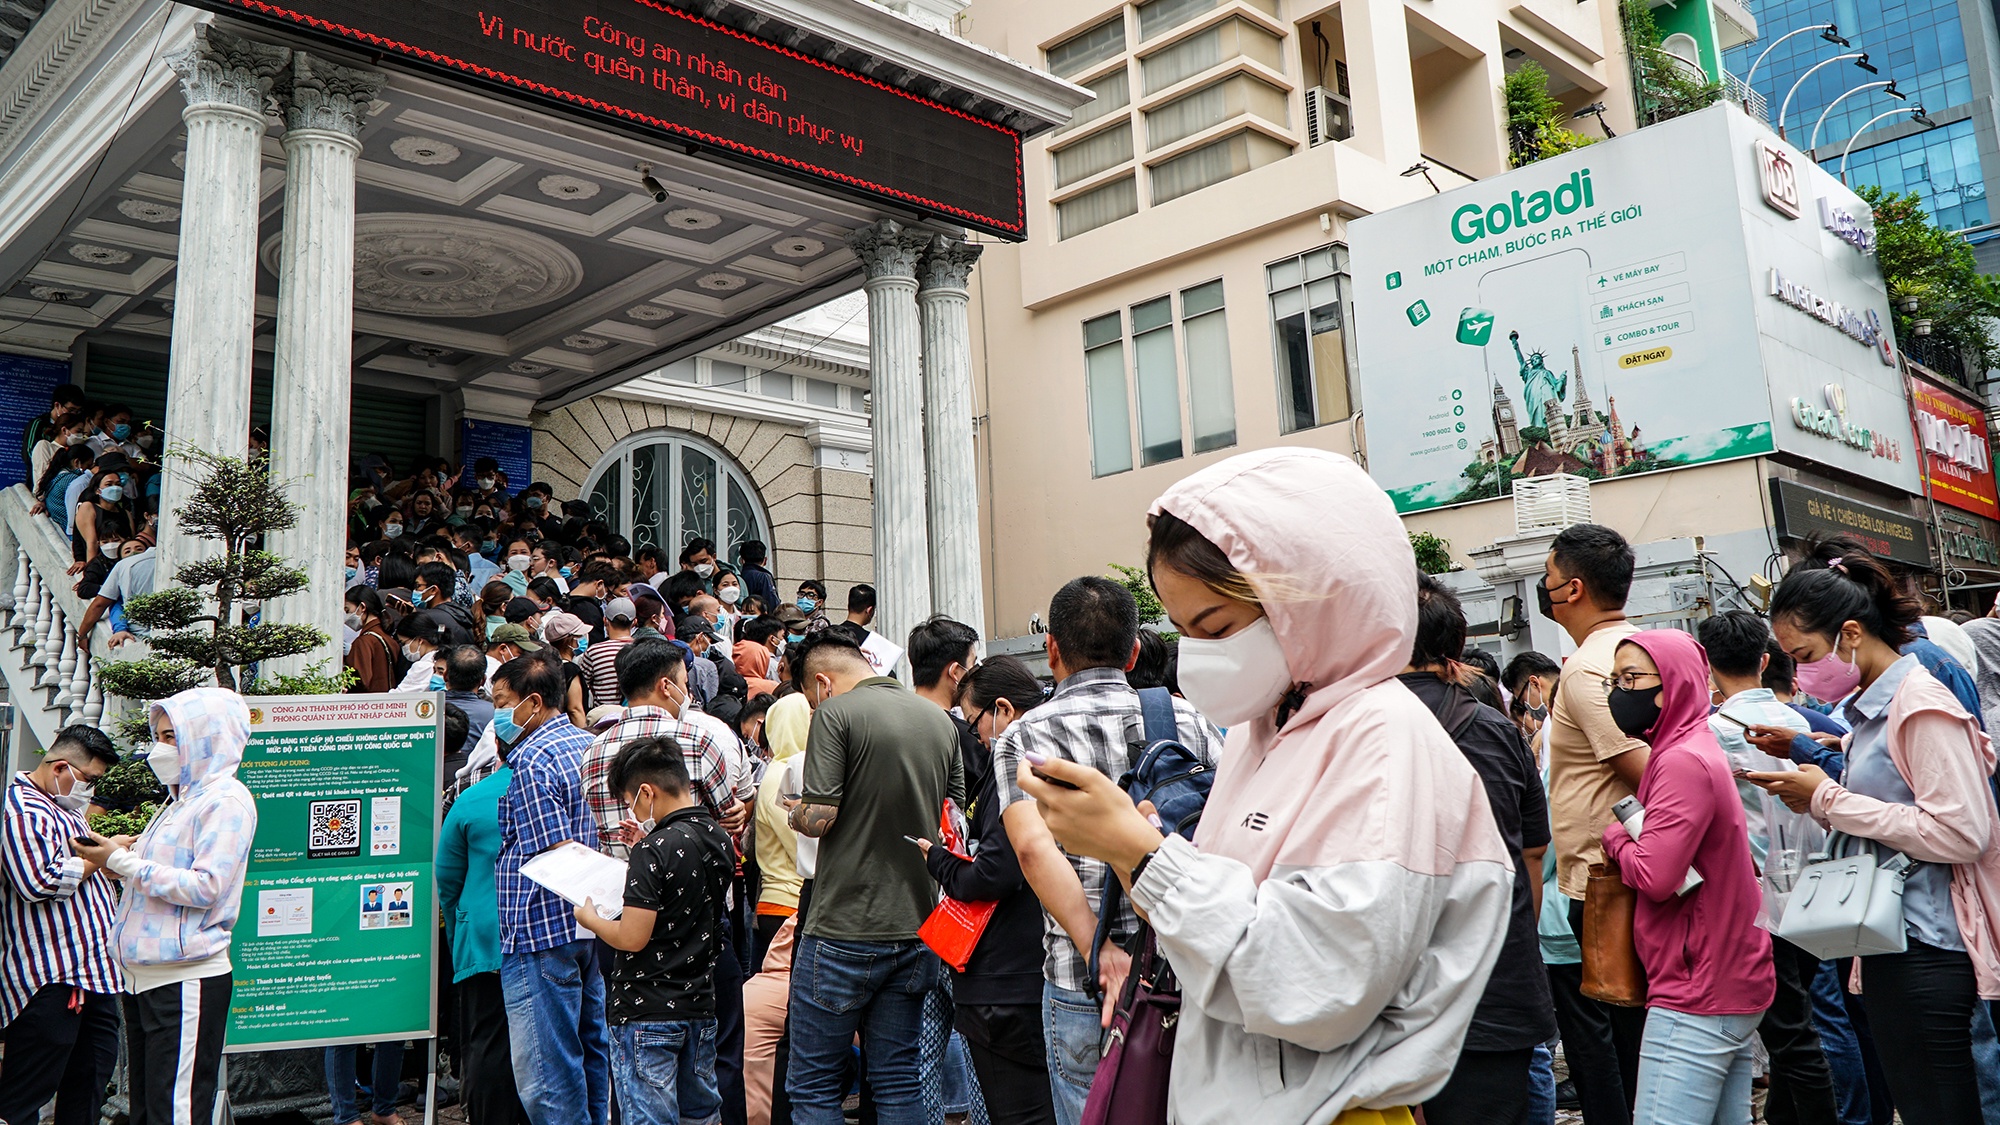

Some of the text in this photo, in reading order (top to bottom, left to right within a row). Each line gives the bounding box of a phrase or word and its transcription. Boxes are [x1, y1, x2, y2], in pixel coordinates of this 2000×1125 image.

[583, 16, 787, 101] Công an nhân dân
[479, 11, 863, 156] Vì nước quên thân, vì dân phục vụ
[1451, 168, 1594, 244] Gotadi
[1424, 204, 1642, 276] MỘT CHẠM, BƯỚC RA THẾ GIỚI
[1613, 265, 1660, 281] VÉ MÁY BAY
[1617, 296, 1663, 312] KHÁCH SẠN
[1617, 329, 1647, 341] COMBO
[1657, 322, 1679, 332] TOUR
[1626, 350, 1666, 365] ĐẶT NGAY
[1429, 412, 1449, 420] Android
[1437, 427, 1451, 435] 9002
[1410, 444, 1453, 456] www.gotadi.com
[1937, 459, 1971, 482] CALENDAR
[1808, 498, 1821, 517] GIÁ
[1821, 501, 1832, 520] VÉ
[1832, 507, 1837, 521] 1
[1838, 508, 1858, 526] CHIỀU
[1858, 511, 1870, 530] ĐẾN
[1871, 518, 1885, 533] LOS
[1885, 520, 1913, 541] ANGELES
[273, 714, 300, 722] PHÒNG
[360, 712, 382, 720] NHẬP
[266, 736, 279, 745] DẪN
[310, 735, 322, 743] CẤP
[325, 735, 333, 744] HỘ
[336, 734, 354, 742] CHIẾU
[356, 734, 377, 742] KHÔNG
[410, 732, 424, 740] ĐIỆN
[283, 745, 292, 754] ĐỘ
[319, 743, 336, 751] CỔNG
[338, 744, 352, 752] DỊCH
[354, 743, 363, 751] VỤ
[383, 741, 400, 749] QUỐC
[290, 876, 304, 884] Cổng
